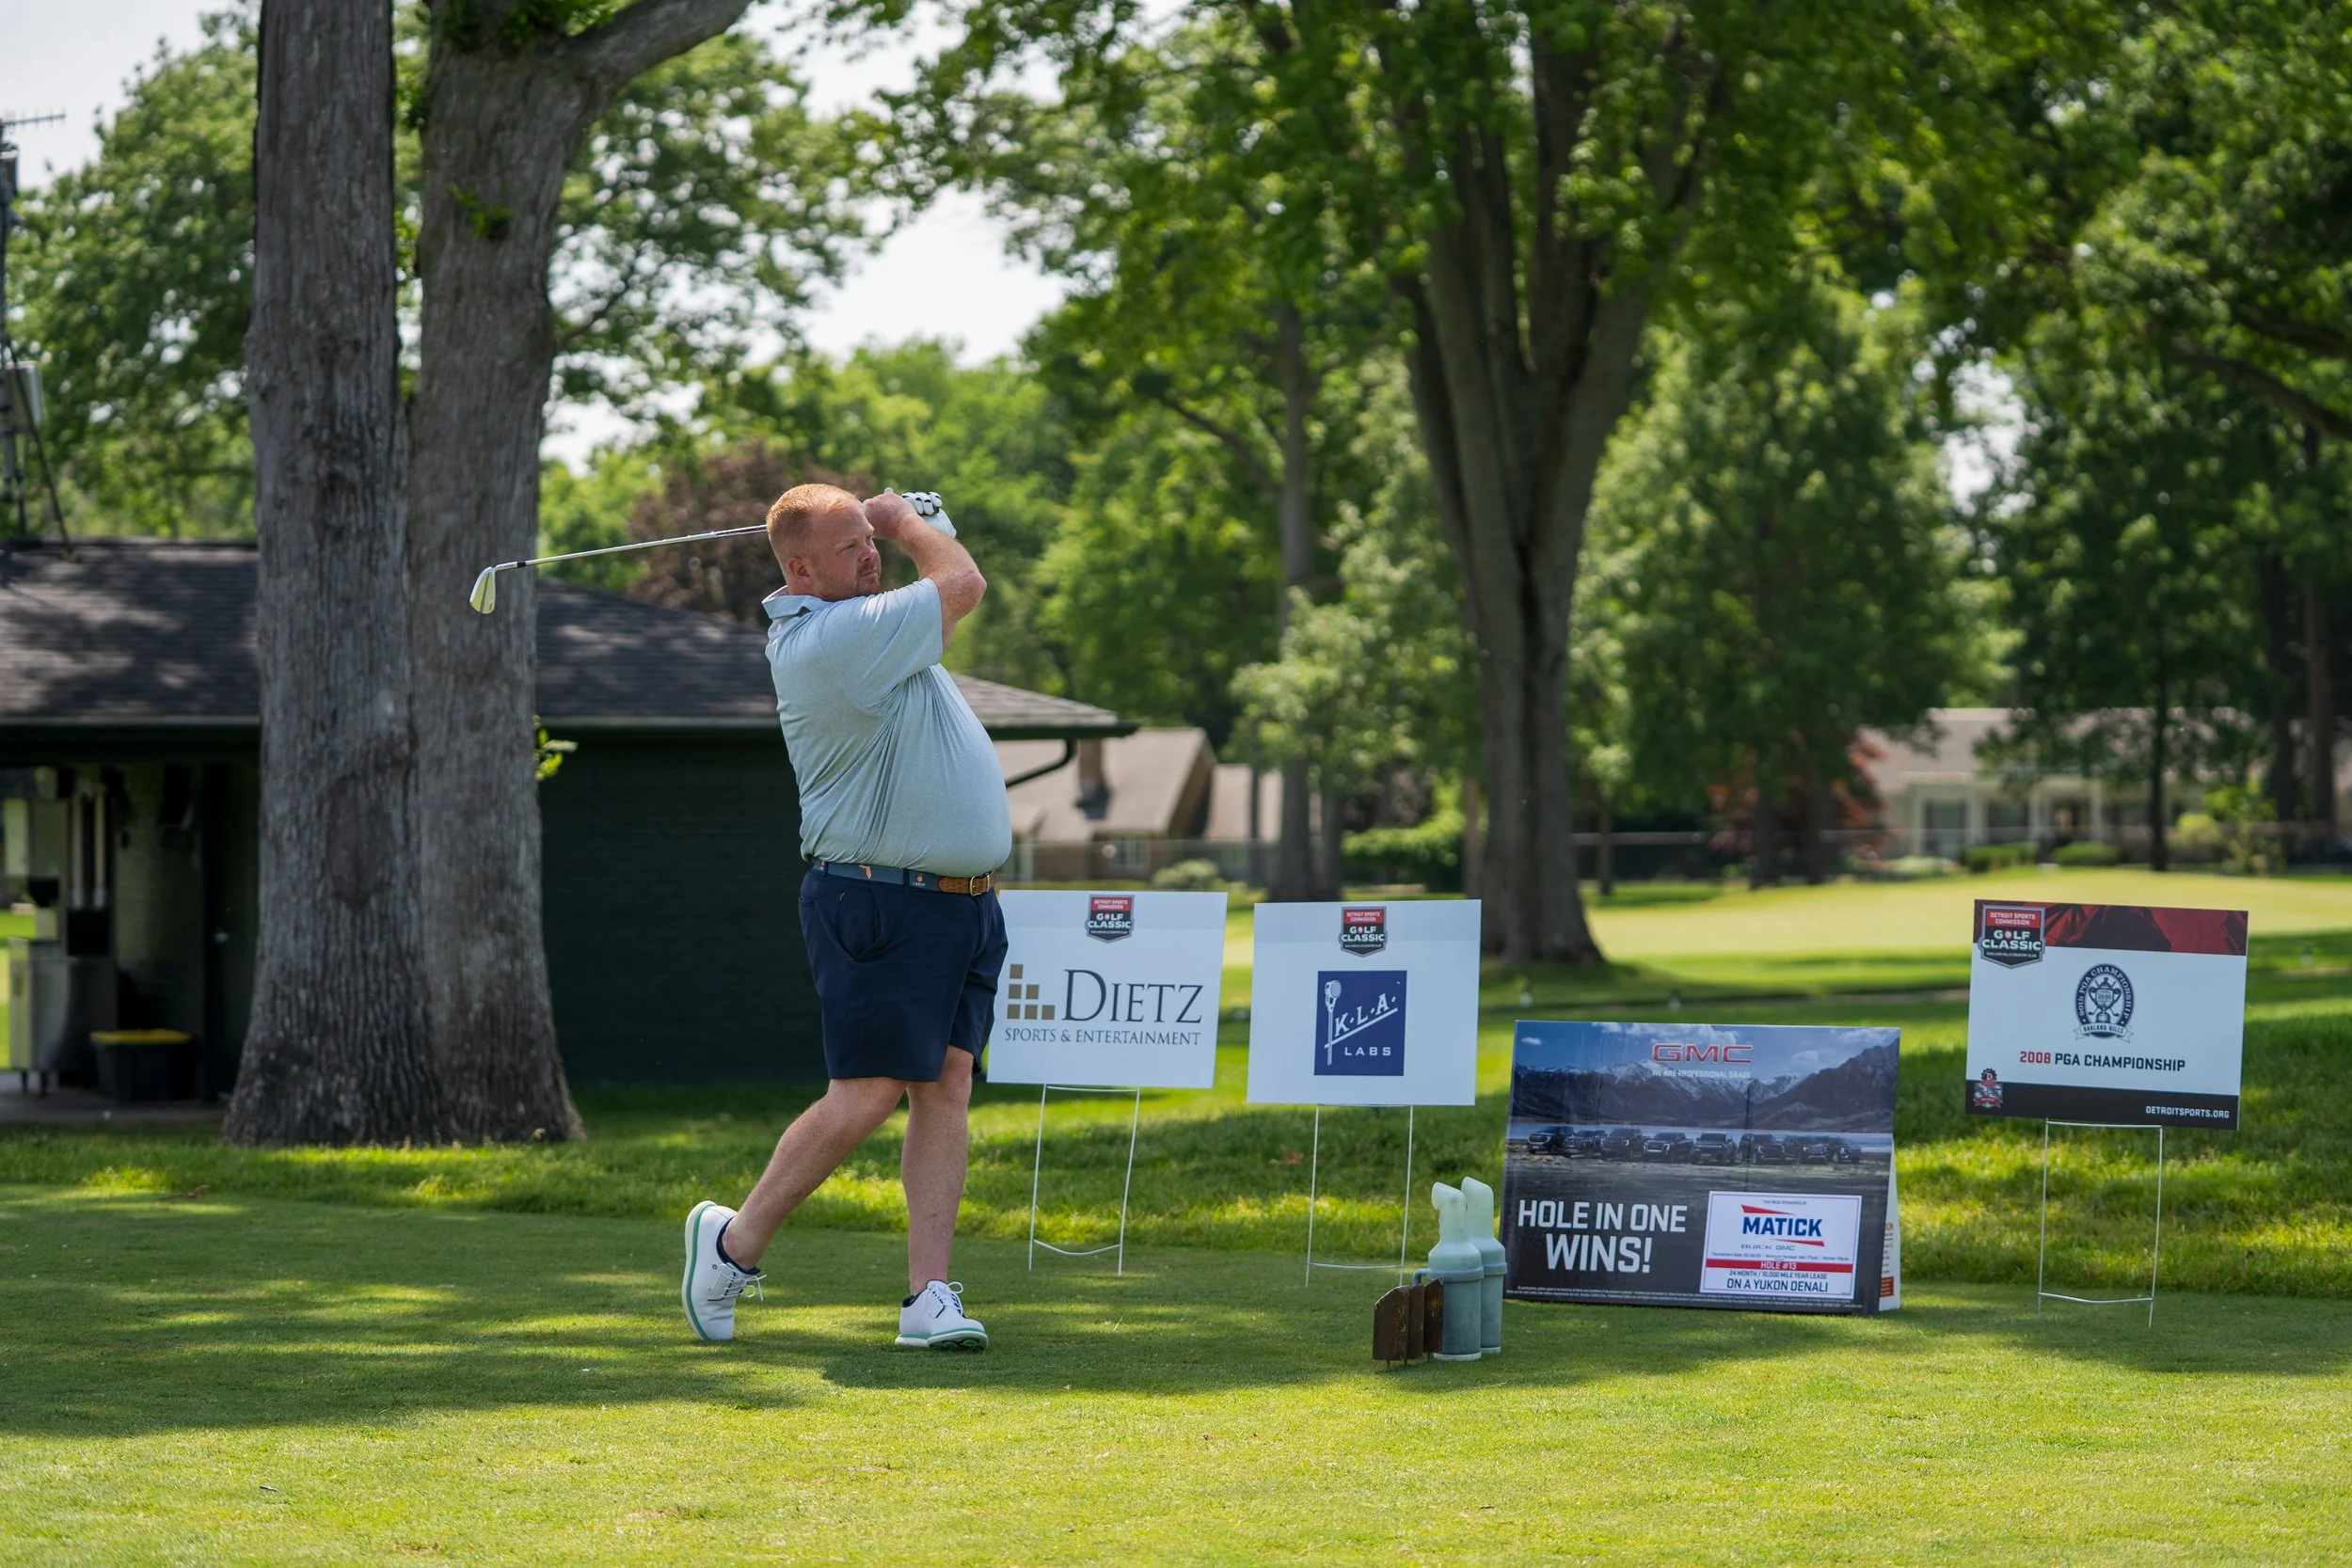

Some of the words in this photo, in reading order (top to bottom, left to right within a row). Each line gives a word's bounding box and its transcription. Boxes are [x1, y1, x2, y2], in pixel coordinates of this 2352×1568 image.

[1341, 933, 1385, 942] CLASSIC
[1981, 939, 2042, 951] CLASSIC
[1061, 969, 1203, 1023] DIETZ
[2079, 976, 2091, 993] PGA
[2090, 966, 2132, 1020] CHAMPIONSHIP
[1005, 1027, 1057, 1042] SPORTS
[1060, 1029, 1072, 1042] &
[1075, 1029, 1200, 1046] ENTERTAINMENT
[2108, 1025, 2124, 1034] HILLS
[1344, 1046, 1391, 1056] LABS
[1653, 1042, 1753, 1065] GMC
[2020, 1051, 2051, 1064] 2008
[2055, 1053, 2081, 1066] PGA
[2084, 1054, 2185, 1071] CHAMPIONSHIP
[2146, 1105, 2230, 1118] DETROITSPORTS.ORG
[1518, 1199, 1590, 1229] HOLE
[1596, 1202, 1624, 1230] IN
[1629, 1204, 1688, 1232] ONE
[1742, 1216, 1822, 1237] MATICK
[1546, 1233, 1652, 1273] WINS!
[1760, 1261, 1781, 1270] HOLE
[1726, 1278, 1741, 1289] ON
[1744, 1279, 1751, 1290] A
[1754, 1279, 1788, 1291] YUKON
[1790, 1280, 1828, 1292] DENALI
